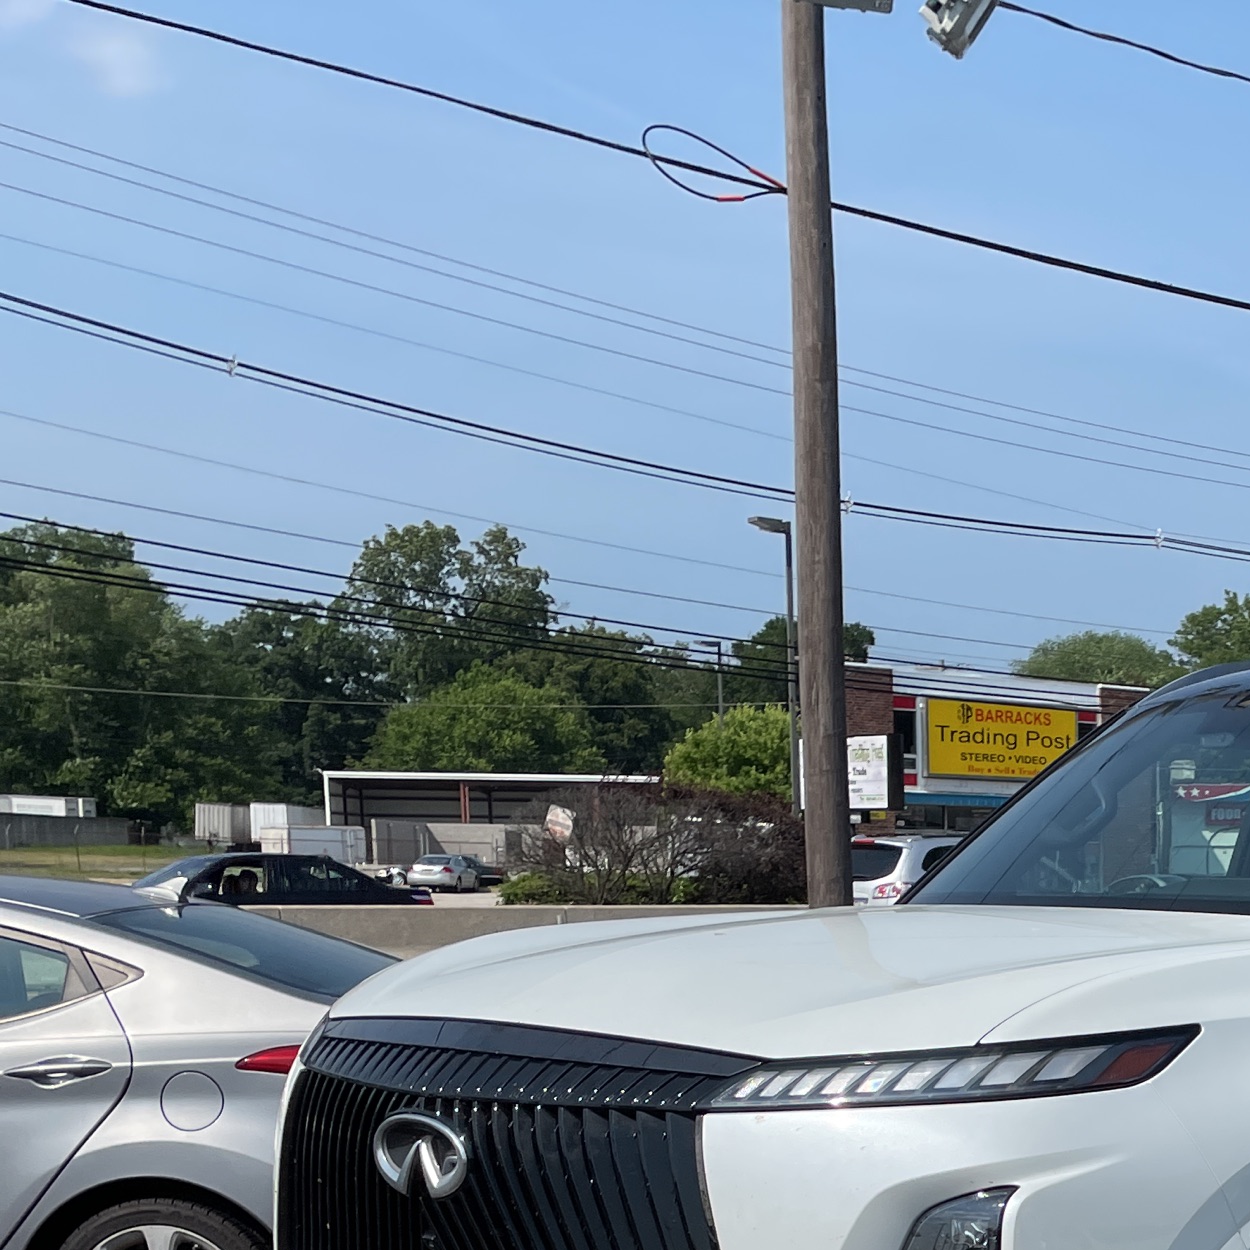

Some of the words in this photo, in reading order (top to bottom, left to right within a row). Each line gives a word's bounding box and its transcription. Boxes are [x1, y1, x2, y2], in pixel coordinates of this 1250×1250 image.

[975, 708, 1052, 726] BARRACKS
[935, 724, 1018, 750] Trading
[1026, 730, 1071, 749] Post
[960, 752, 1005, 763] STEREO
[1014, 755, 1047, 765] VIDEO
[1210, 808, 1241, 820] FOOD
